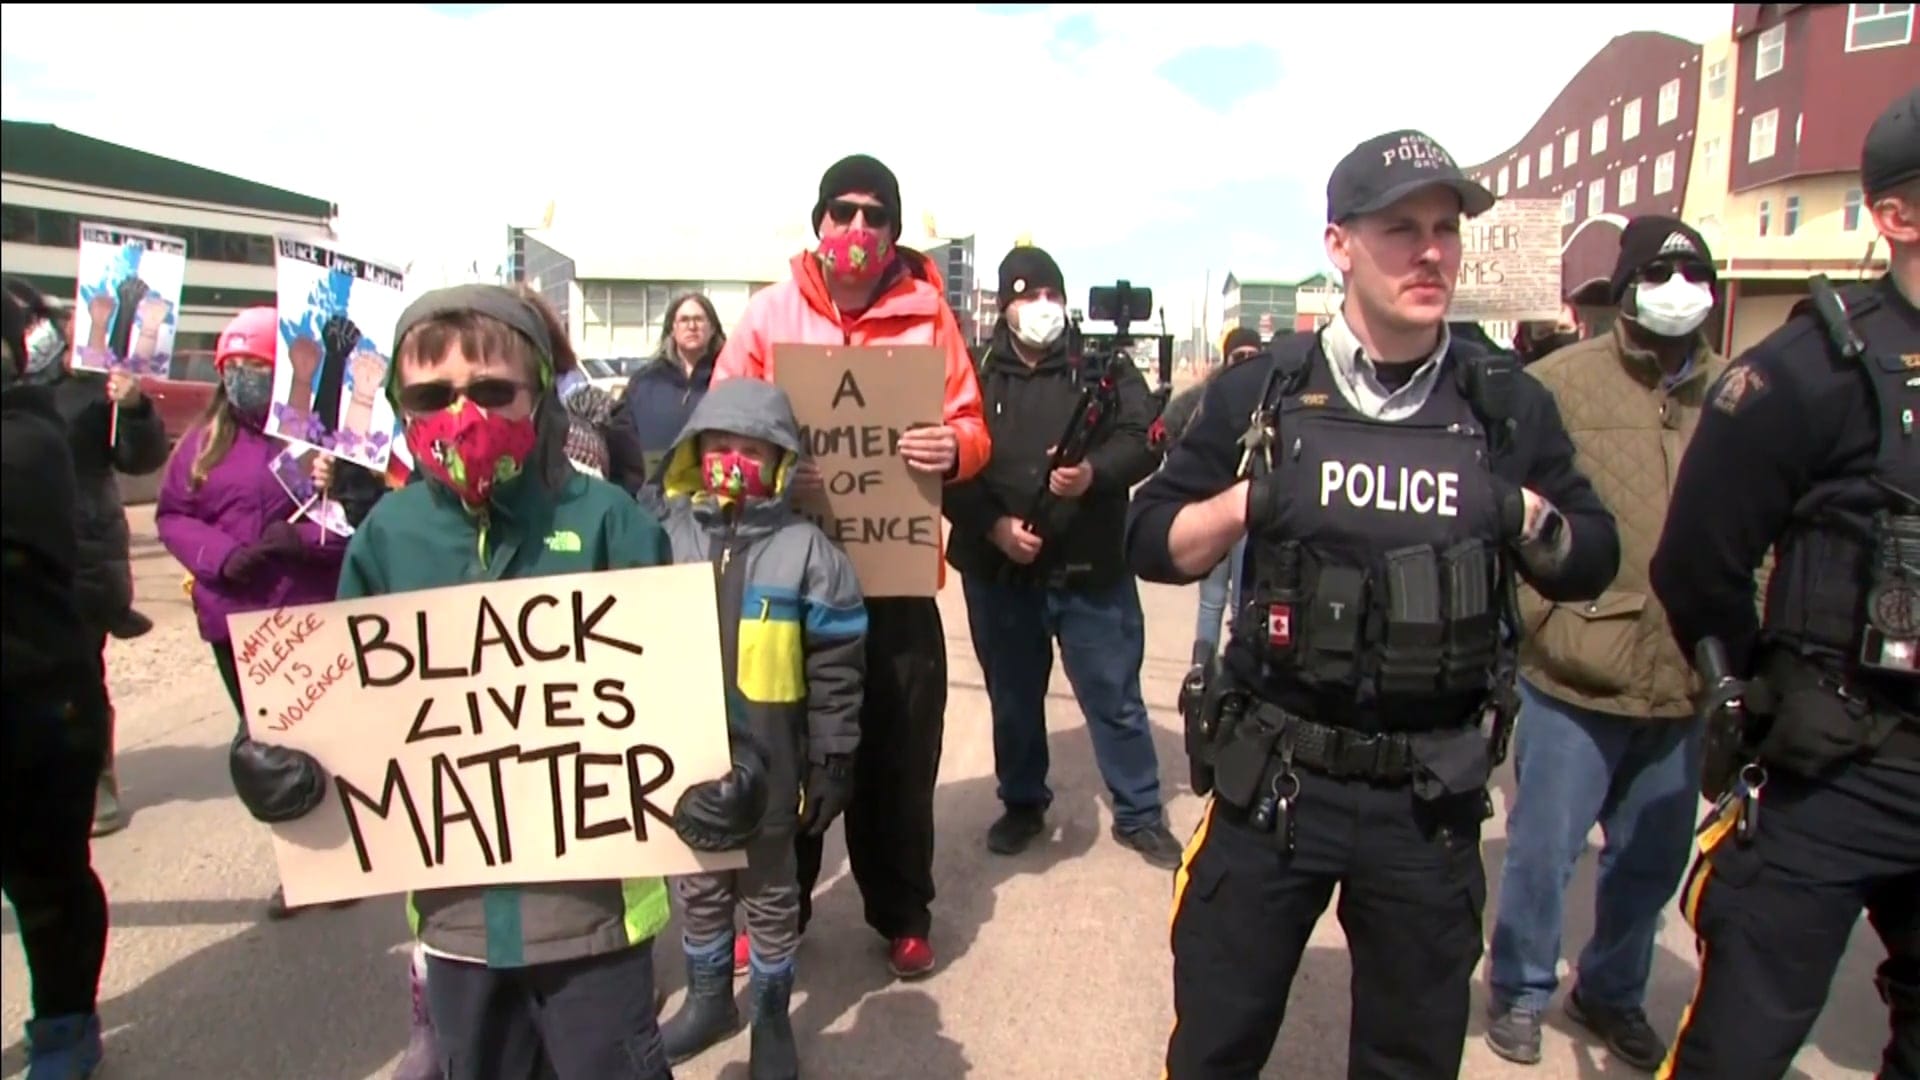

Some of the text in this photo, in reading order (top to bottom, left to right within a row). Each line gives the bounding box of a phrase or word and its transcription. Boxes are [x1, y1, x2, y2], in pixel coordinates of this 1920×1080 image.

[280, 239, 320, 265] Black
[832, 368, 866, 409] A
[830, 470, 883, 495] OF
[1320, 460, 1459, 517] POLICE
[237, 606, 294, 664] WHITE
[248, 612, 325, 686] SILENCE
[347, 590, 644, 689] BLACK
[267, 652, 355, 732] VIOLENCE
[283, 661, 313, 686] IS
[405, 678, 636, 744] LIVES
[334, 741, 676, 874] MATTER
